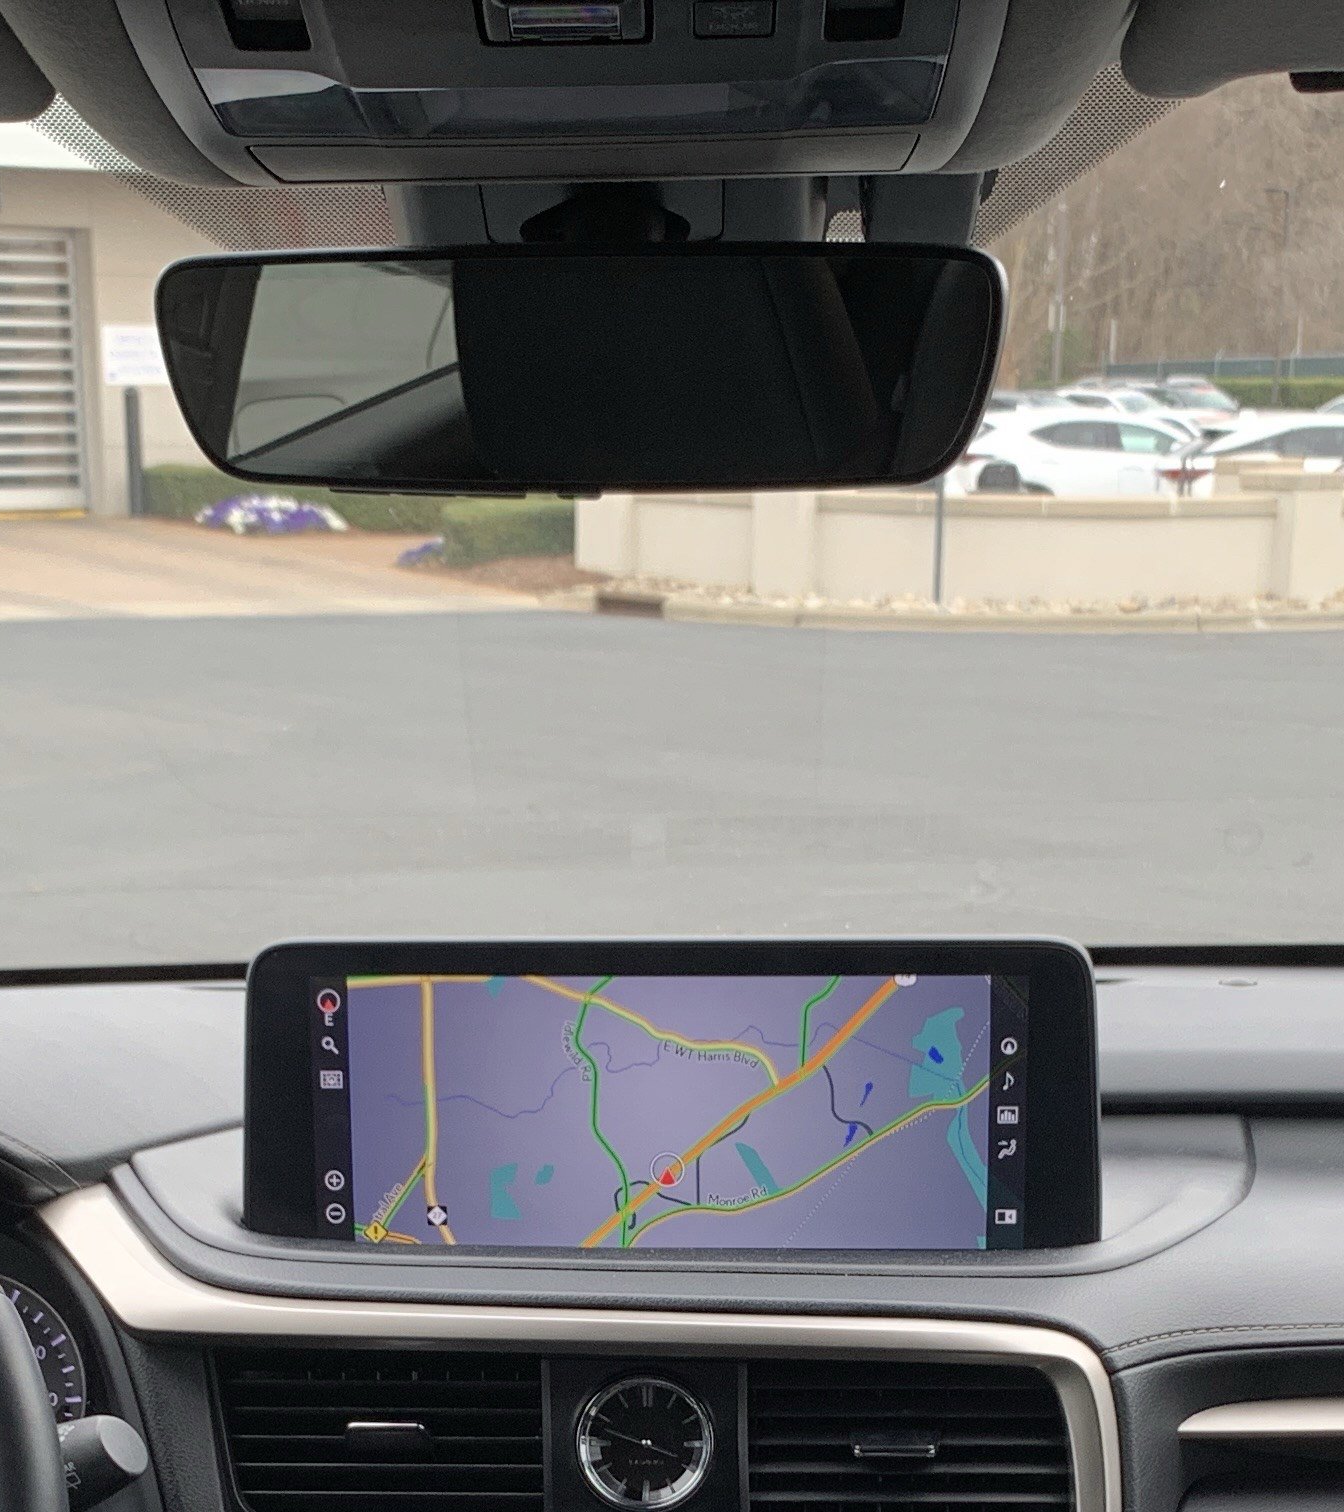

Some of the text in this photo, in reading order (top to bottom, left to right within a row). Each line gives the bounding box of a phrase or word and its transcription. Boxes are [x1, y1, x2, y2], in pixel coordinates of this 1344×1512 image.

[325, 1013, 335, 1027] E
[562, 1022, 593, 1083] Idlewild Rd
[663, 1040, 758, 1069] E WT Harris Blvd
[384, 1183, 404, 1205] Ave
[708, 1186, 768, 1208] Monroe Rd
